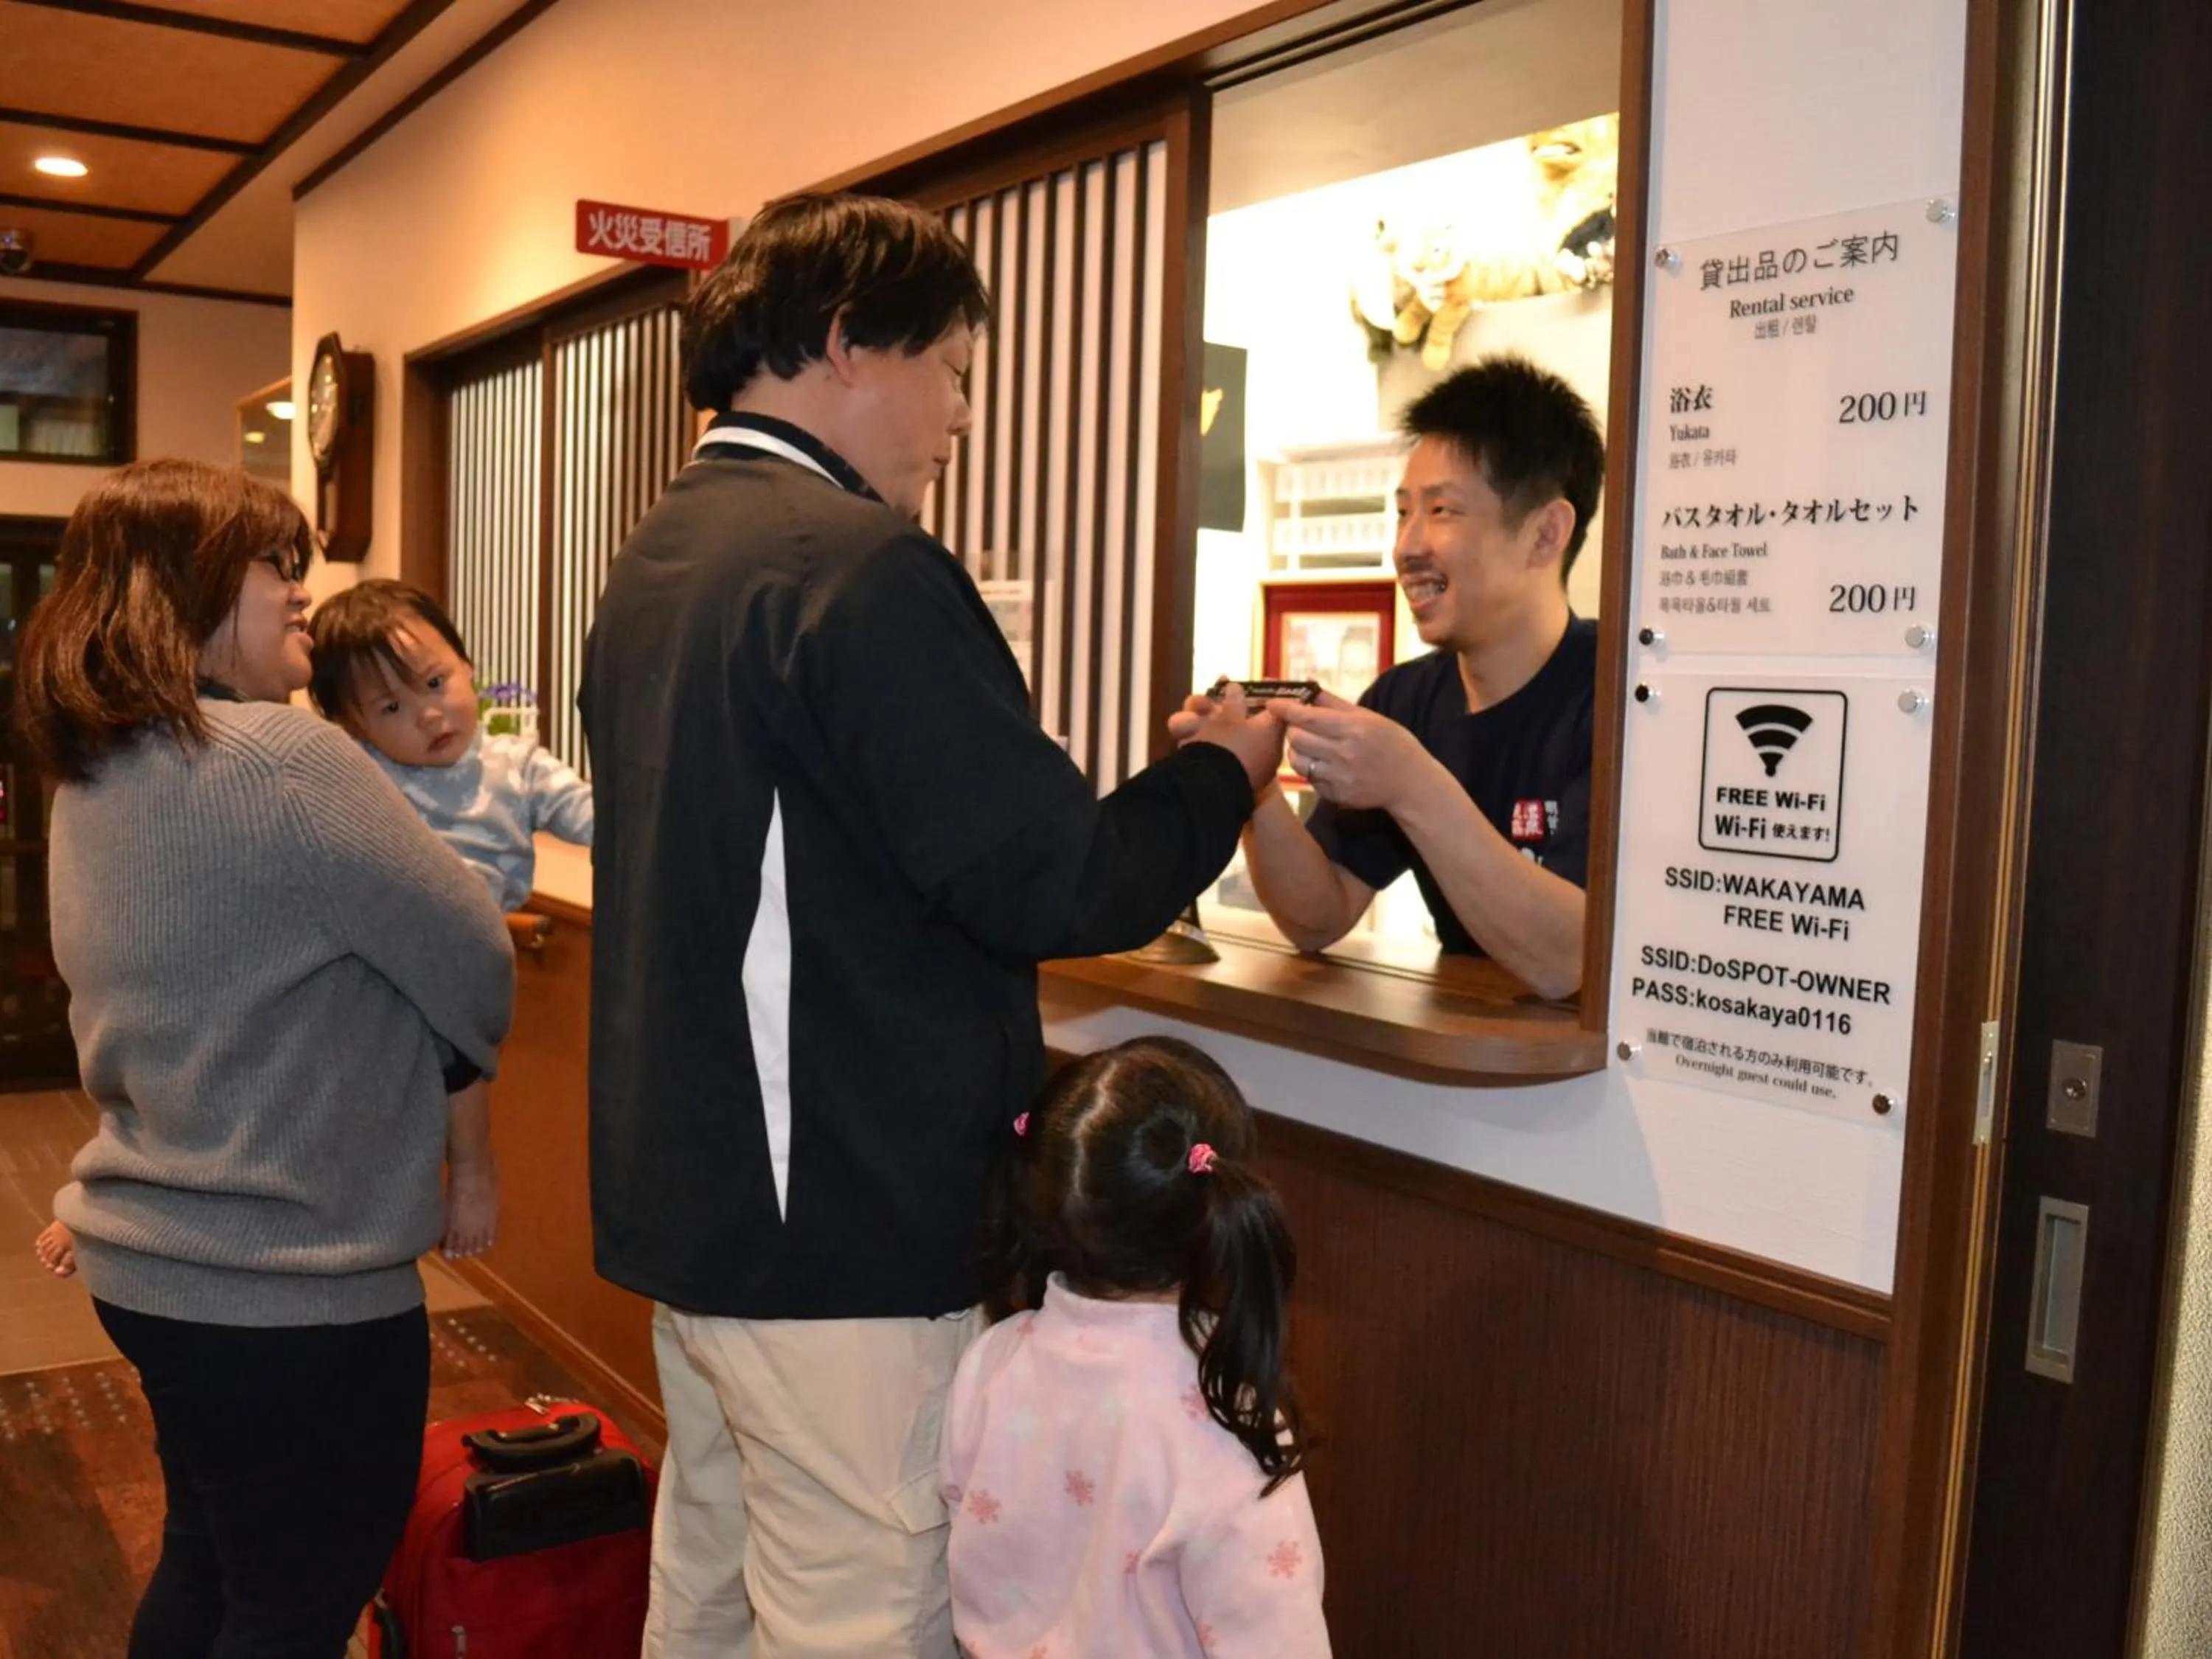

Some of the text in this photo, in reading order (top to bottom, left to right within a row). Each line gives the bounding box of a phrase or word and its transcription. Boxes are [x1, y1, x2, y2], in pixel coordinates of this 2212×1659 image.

[588, 209, 712, 262] 火災受信所
[1700, 230, 1899, 291] 貸出品のご案内
[1730, 286, 1854, 319] Rental service
[1669, 384, 1713, 414] 浴衣
[1670, 424, 1710, 441] Yukata
[1660, 543, 1686, 559] Bath
[1702, 543, 1728, 558] Face
[1731, 542, 1767, 557] Towel
[1716, 787, 1826, 811] FREE Wi-Fi
[1714, 815, 1767, 840] Wi-Fi
[1665, 866, 1865, 910] SSID:WAKAYAMA
[1723, 905, 1849, 942] FREE Wi-Fi
[1641, 945, 1891, 1005] SSID:DoSPOT-OWNER
[1632, 977, 1851, 1035] PASS:kosakaya0116
[1675, 1053, 1734, 1077] Overnight
[1736, 1068, 1769, 1085] guest
[1773, 1077, 1806, 1093] could
